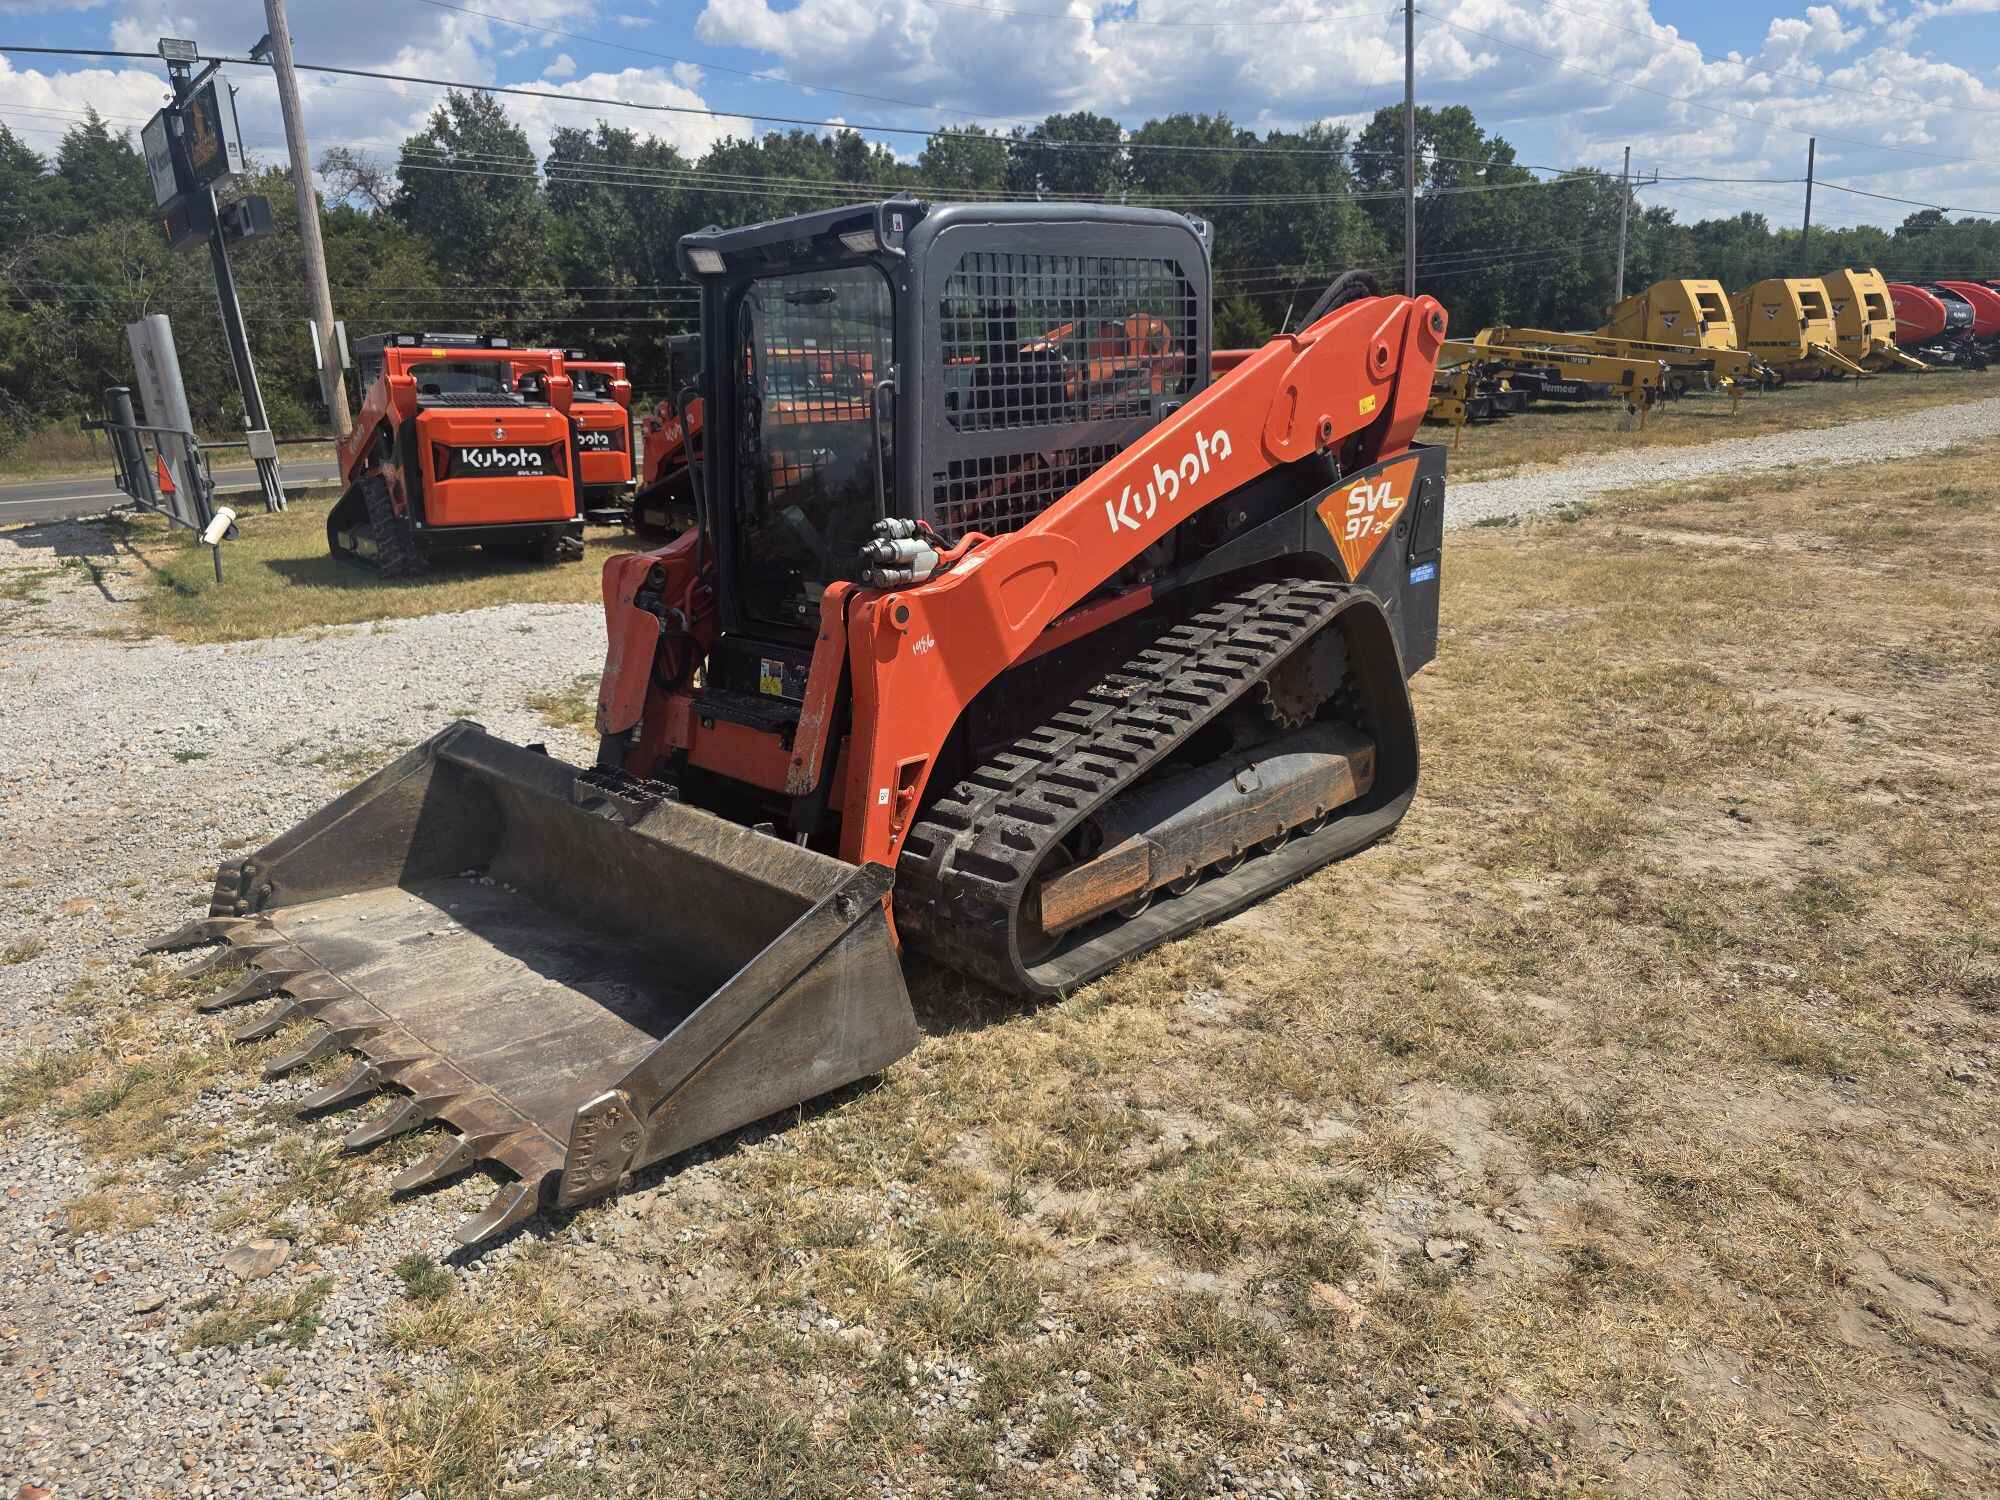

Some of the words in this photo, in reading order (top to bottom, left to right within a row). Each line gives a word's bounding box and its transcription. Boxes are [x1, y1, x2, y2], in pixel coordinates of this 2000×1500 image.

[1541, 383, 1577, 394] Vermeer
[577, 432, 609, 445] bota
[462, 447, 542, 468] Kubota
[1105, 429, 1232, 534] Kubota
[1345, 482, 1399, 517] SVL
